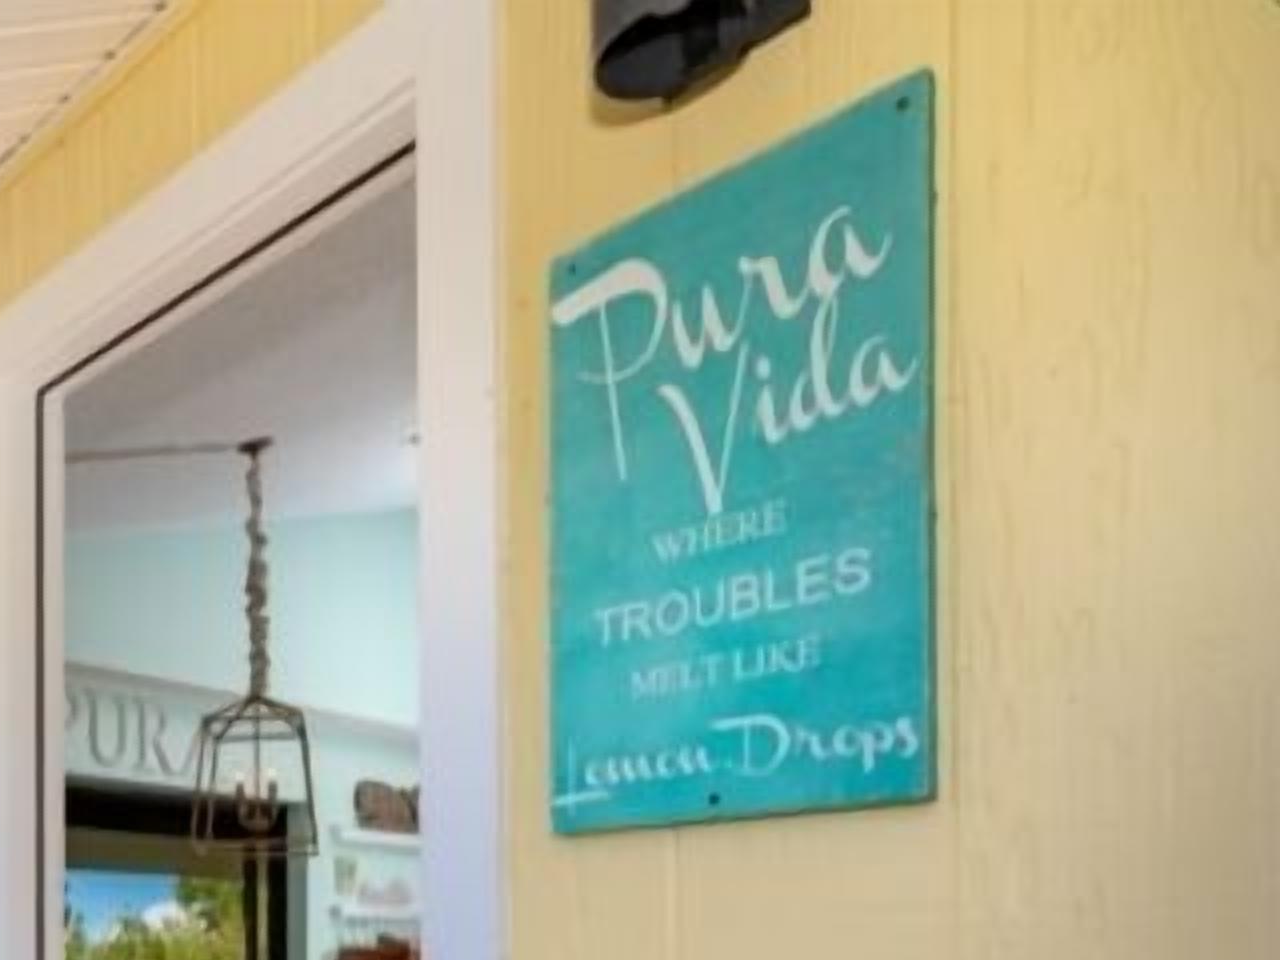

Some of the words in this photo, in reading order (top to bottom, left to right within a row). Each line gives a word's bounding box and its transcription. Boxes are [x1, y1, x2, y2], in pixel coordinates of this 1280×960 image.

[551, 205, 894, 480] Pura
[657, 294, 920, 514] Vida
[651, 498, 790, 562] WHERE
[593, 546, 873, 649] TROUBLES
[630, 654, 721, 700] MELT
[732, 634, 822, 682] LIKE
[550, 736, 713, 816] Lemon
[709, 713, 921, 778] Drops
